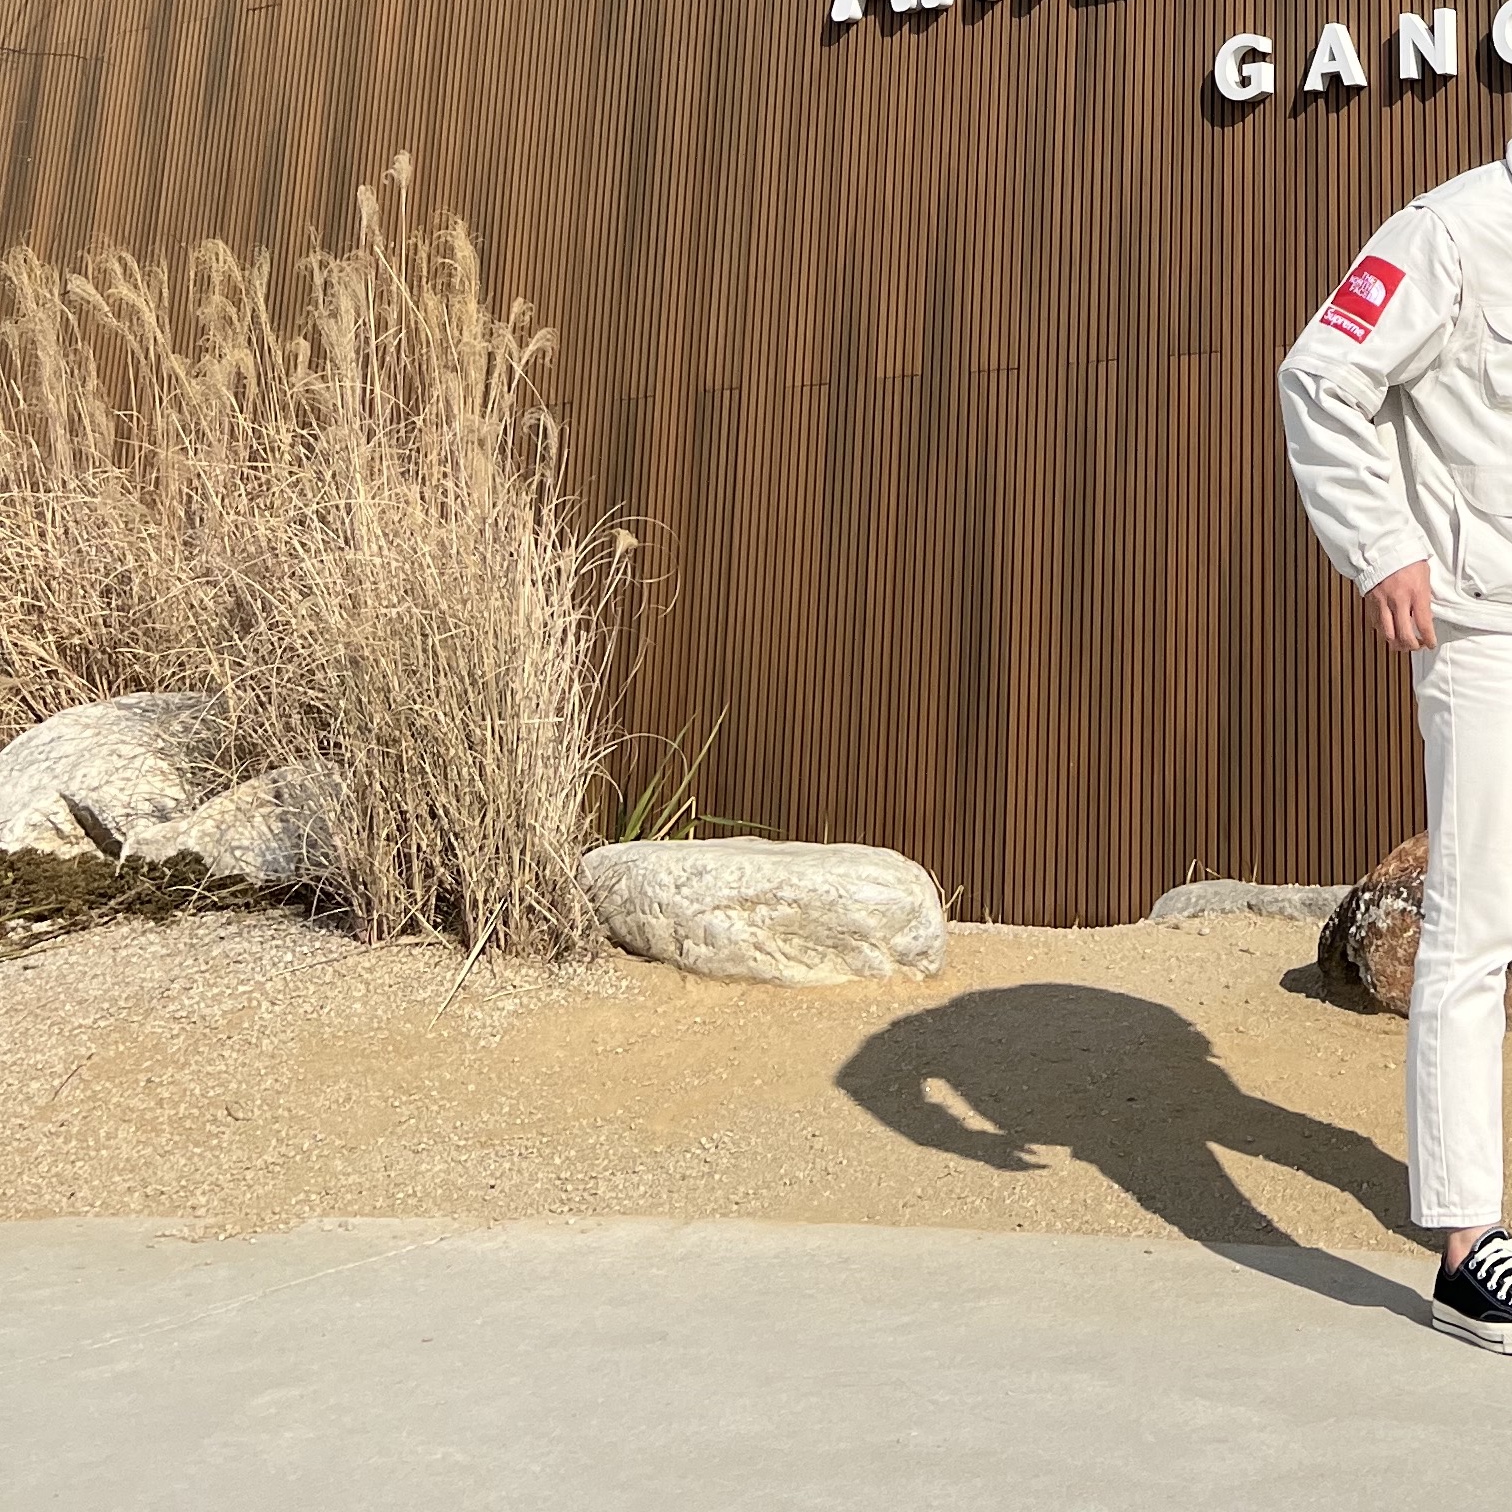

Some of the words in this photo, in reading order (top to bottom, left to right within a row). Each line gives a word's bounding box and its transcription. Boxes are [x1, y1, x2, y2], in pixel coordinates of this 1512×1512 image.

[1348, 274, 1371, 293] NORTH
[1361, 271, 1378, 285] THE
[1348, 283, 1369, 299] FACE
[1323, 308, 1365, 336] Supreme
